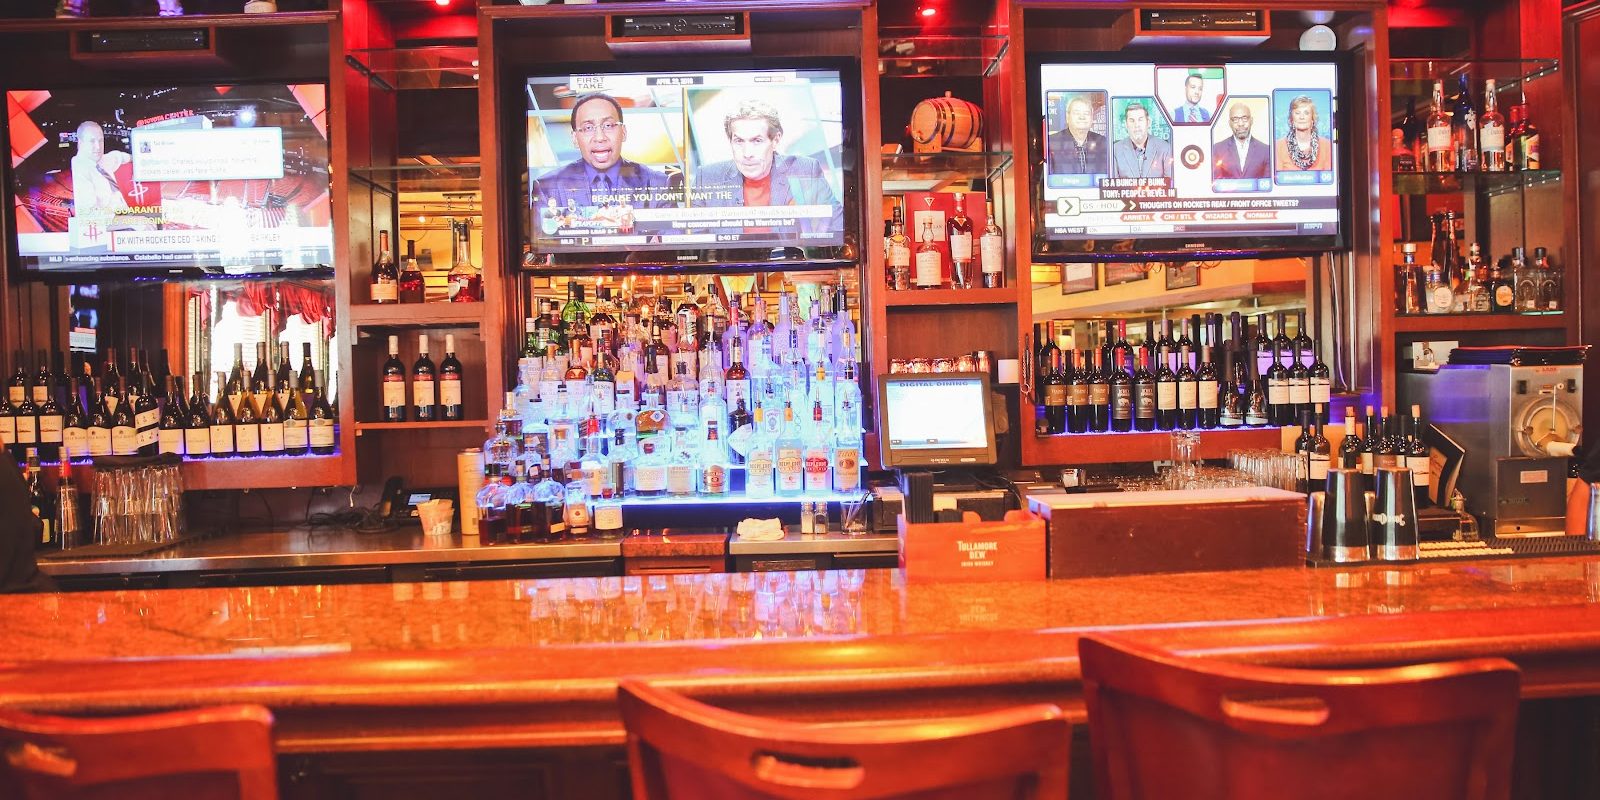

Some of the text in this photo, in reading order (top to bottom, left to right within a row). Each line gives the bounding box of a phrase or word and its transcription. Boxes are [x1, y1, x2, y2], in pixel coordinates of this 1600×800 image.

[164, 109, 194, 120] CENTER
[1102, 177, 1167, 187] IS A BUNCH OF BUNK.
[633, 192, 653, 201] YOU
[656, 192, 685, 202] DON'T
[685, 191, 714, 201] WANT
[716, 190, 734, 200] THE
[1102, 188, 1176, 199] TONY: PEOPLE REVEL IN
[1139, 201, 1173, 209] THOUGHTS
[1230, 200, 1250, 208] FRONT
[1250, 200, 1273, 208] OFFICE
[1272, 199, 1300, 207] TWEETS?
[687, 220, 721, 229] concerned
[720, 219, 744, 228] should
[743, 219, 755, 227] the
[754, 218, 783, 228] Warriors
[782, 218, 796, 227] be?
[116, 236, 127, 245] OK
[127, 236, 145, 245] WITH
[145, 235, 176, 244] ROCKETS
[162, 252, 174, 260] had
[899, 380, 969, 389] DIGITAL DINING
[956, 540, 998, 551] TULLAMORE
[969, 550, 986, 561] DEW
[973, 560, 994, 568] WHISKEY
